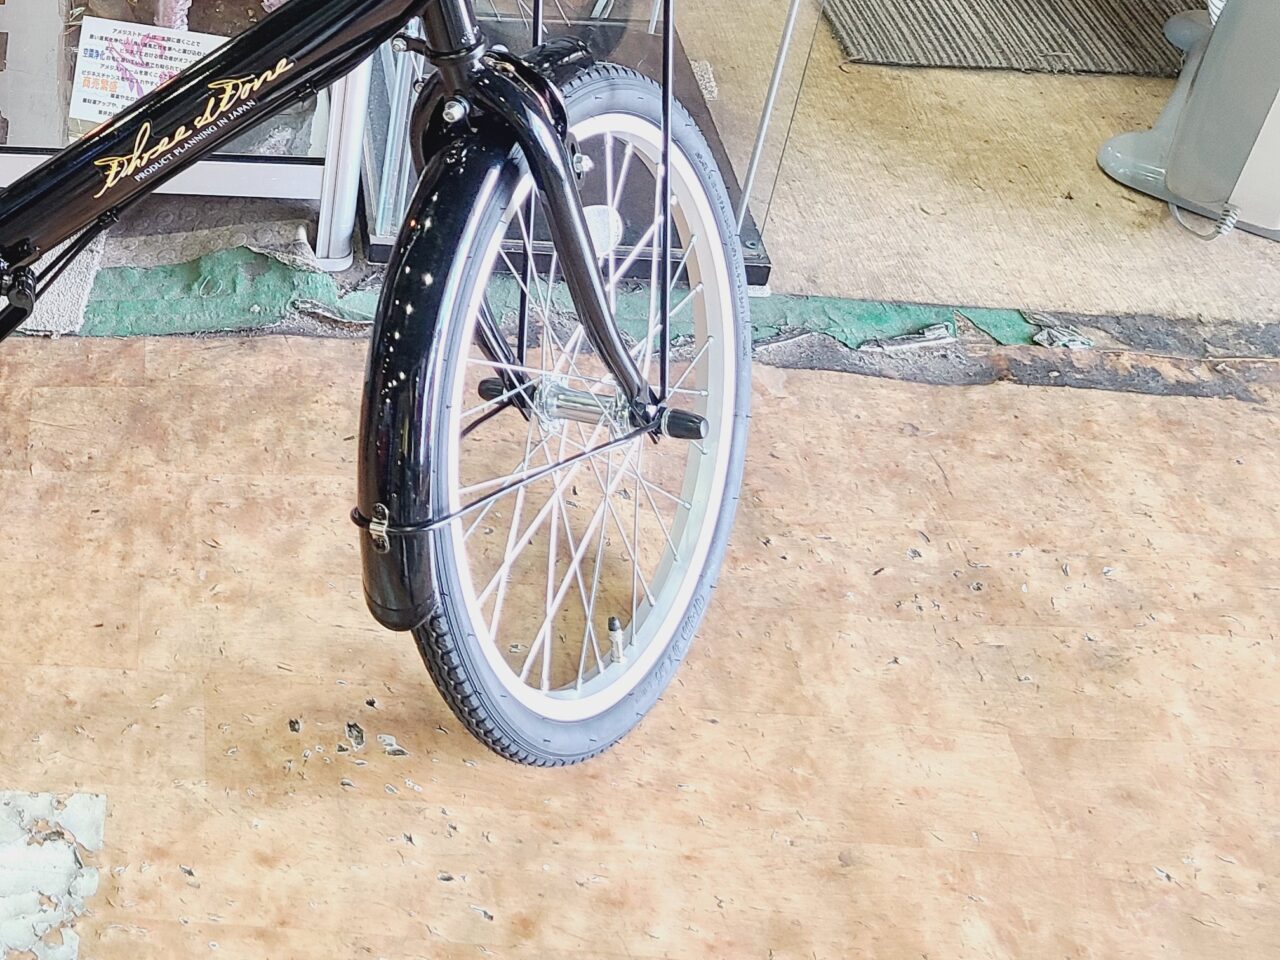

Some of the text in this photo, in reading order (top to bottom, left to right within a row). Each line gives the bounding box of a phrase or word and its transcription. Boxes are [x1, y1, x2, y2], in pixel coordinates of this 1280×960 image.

[134, 98, 256, 183] PRODUCT PLANNING IN JAPAN
